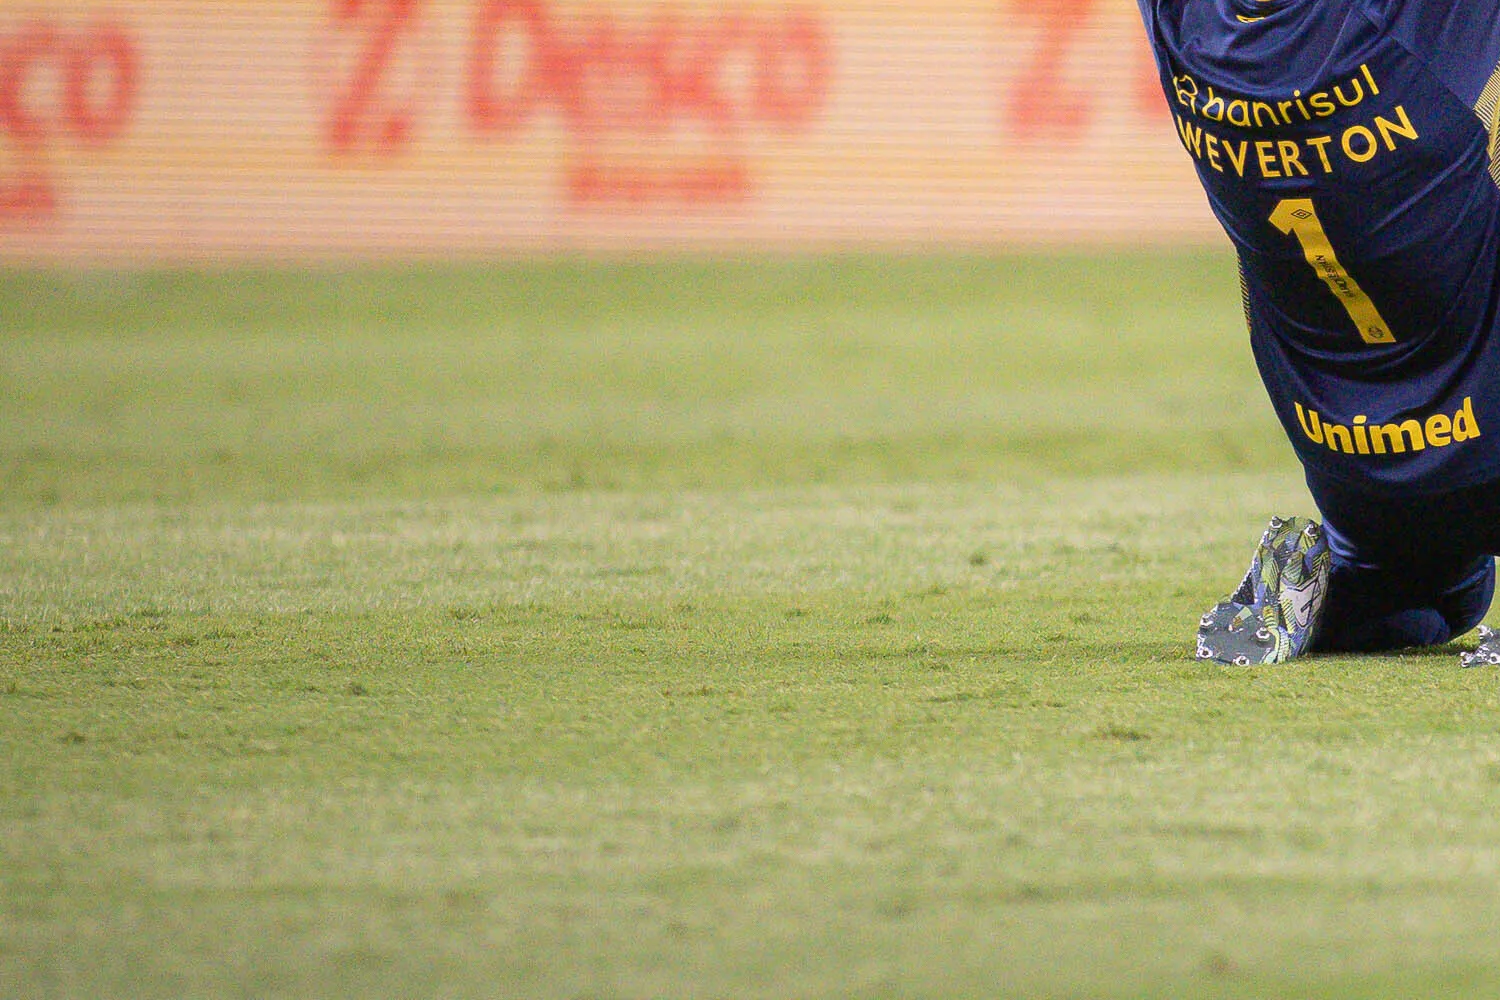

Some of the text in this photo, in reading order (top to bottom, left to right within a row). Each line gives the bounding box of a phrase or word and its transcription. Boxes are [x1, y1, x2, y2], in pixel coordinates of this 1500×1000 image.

[1202, 63, 1380, 127] banrisul
[1176, 105, 1419, 178] WEVERTON
[1268, 198, 1397, 344] 1
[1294, 396, 1481, 454] Unimed
